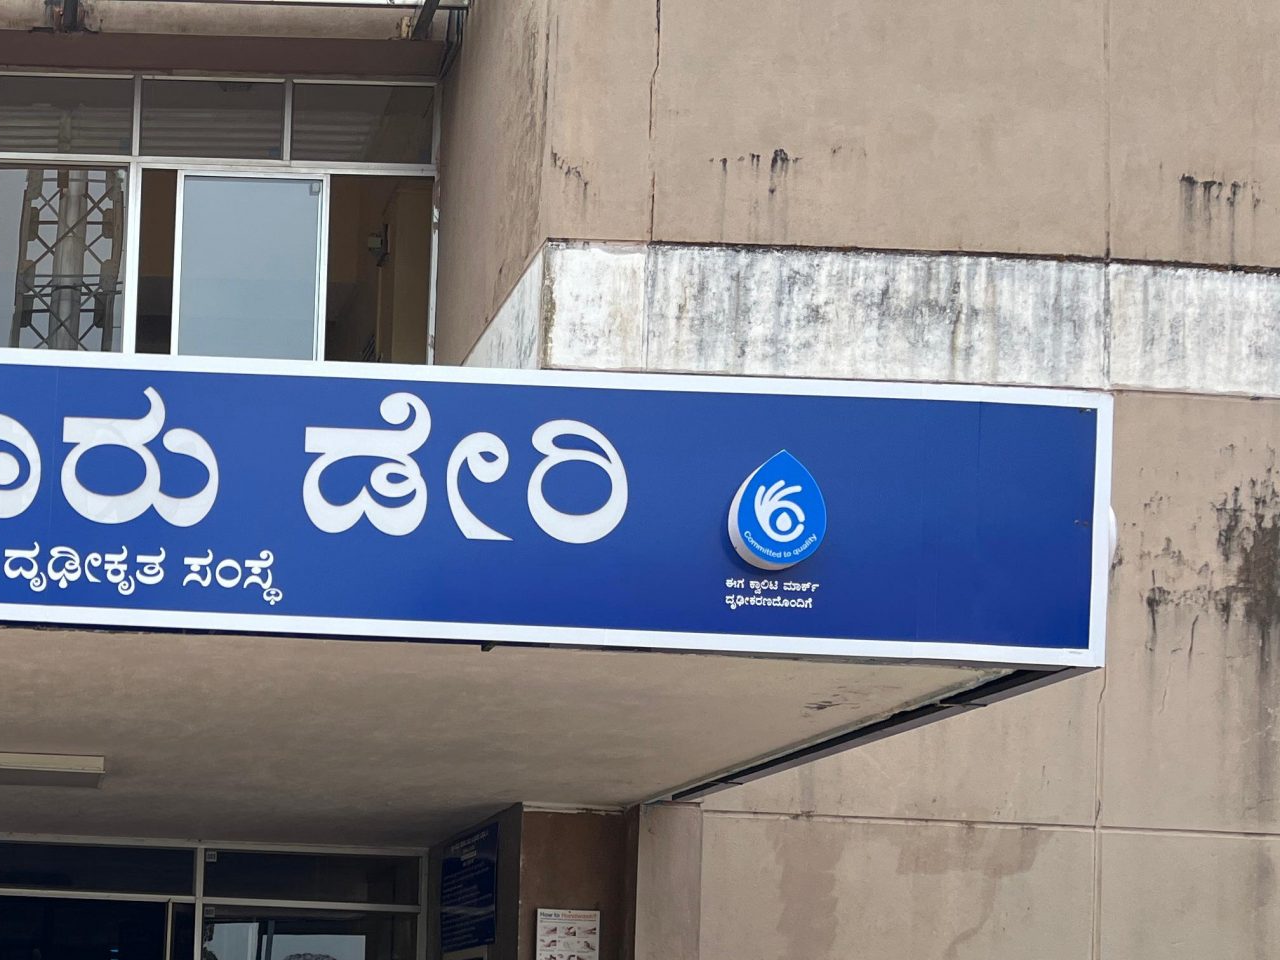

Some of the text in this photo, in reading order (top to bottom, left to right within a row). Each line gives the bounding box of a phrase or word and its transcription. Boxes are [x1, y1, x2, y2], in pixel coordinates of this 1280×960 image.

[303, 392, 628, 544] ಡೇರಿ
[3, 541, 166, 596] ದೃಢೀಕೃತ
[182, 549, 283, 606] ಸಂಸ್ಥೆ
[744, 531, 818, 558] Committed to quality
